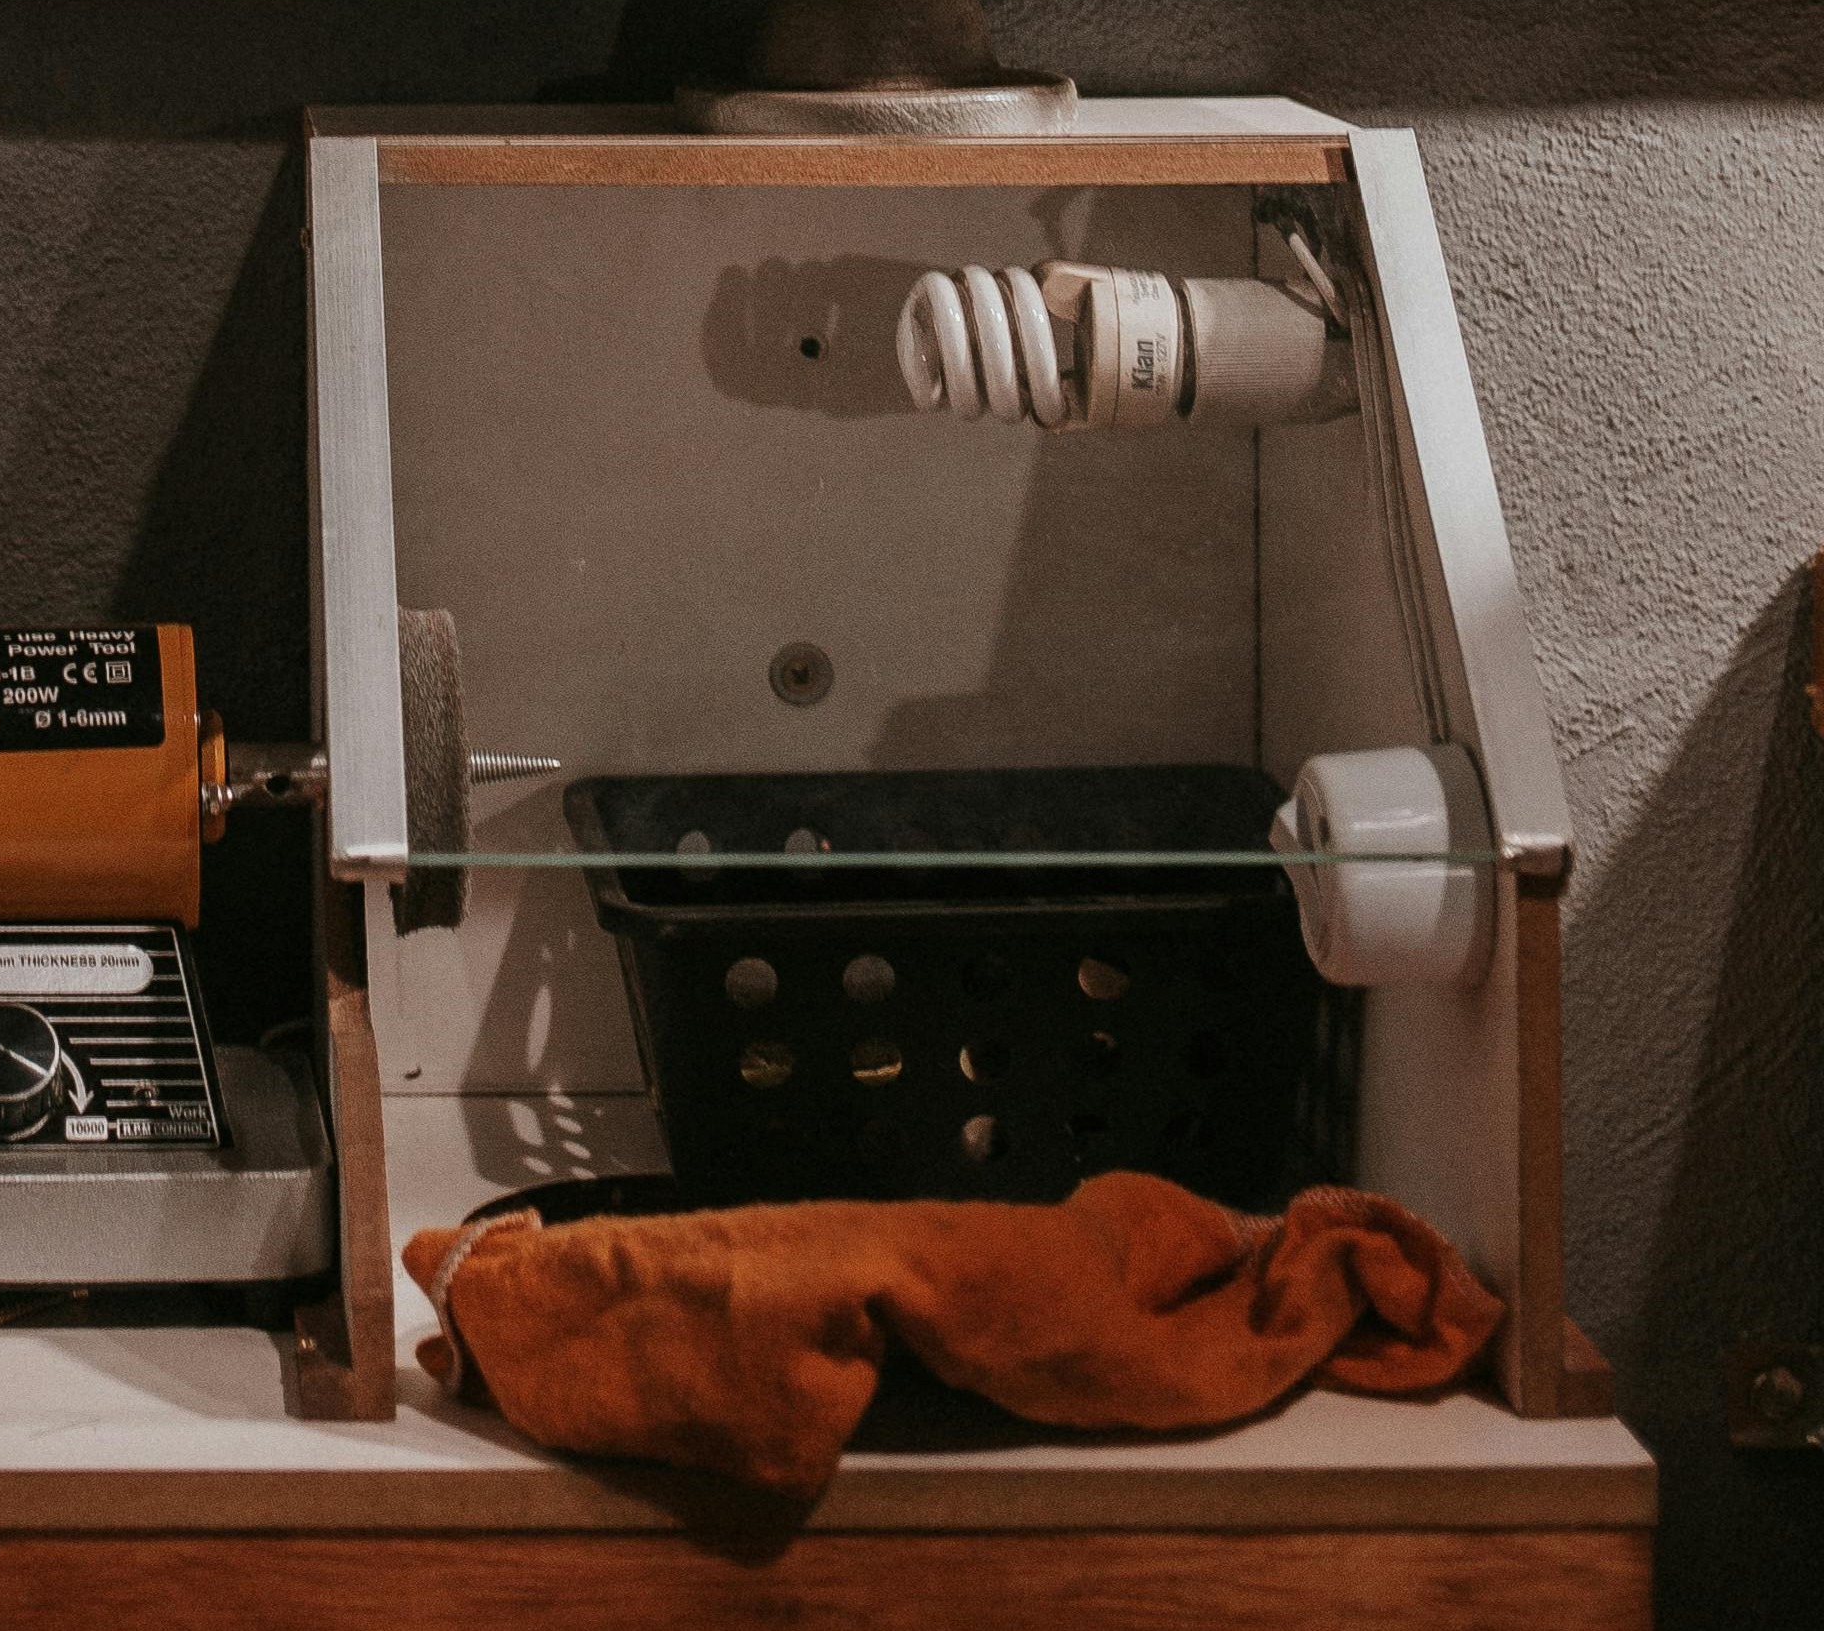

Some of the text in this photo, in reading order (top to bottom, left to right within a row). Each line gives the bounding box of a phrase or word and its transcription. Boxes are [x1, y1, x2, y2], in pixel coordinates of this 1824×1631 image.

[8, 644, 78, 657] Power
[89, 642, 136, 655] Tool
[3, 685, 59, 705] 200W
[168, 1103, 208, 1120] Work
[69, 1121, 106, 1136] 10000
